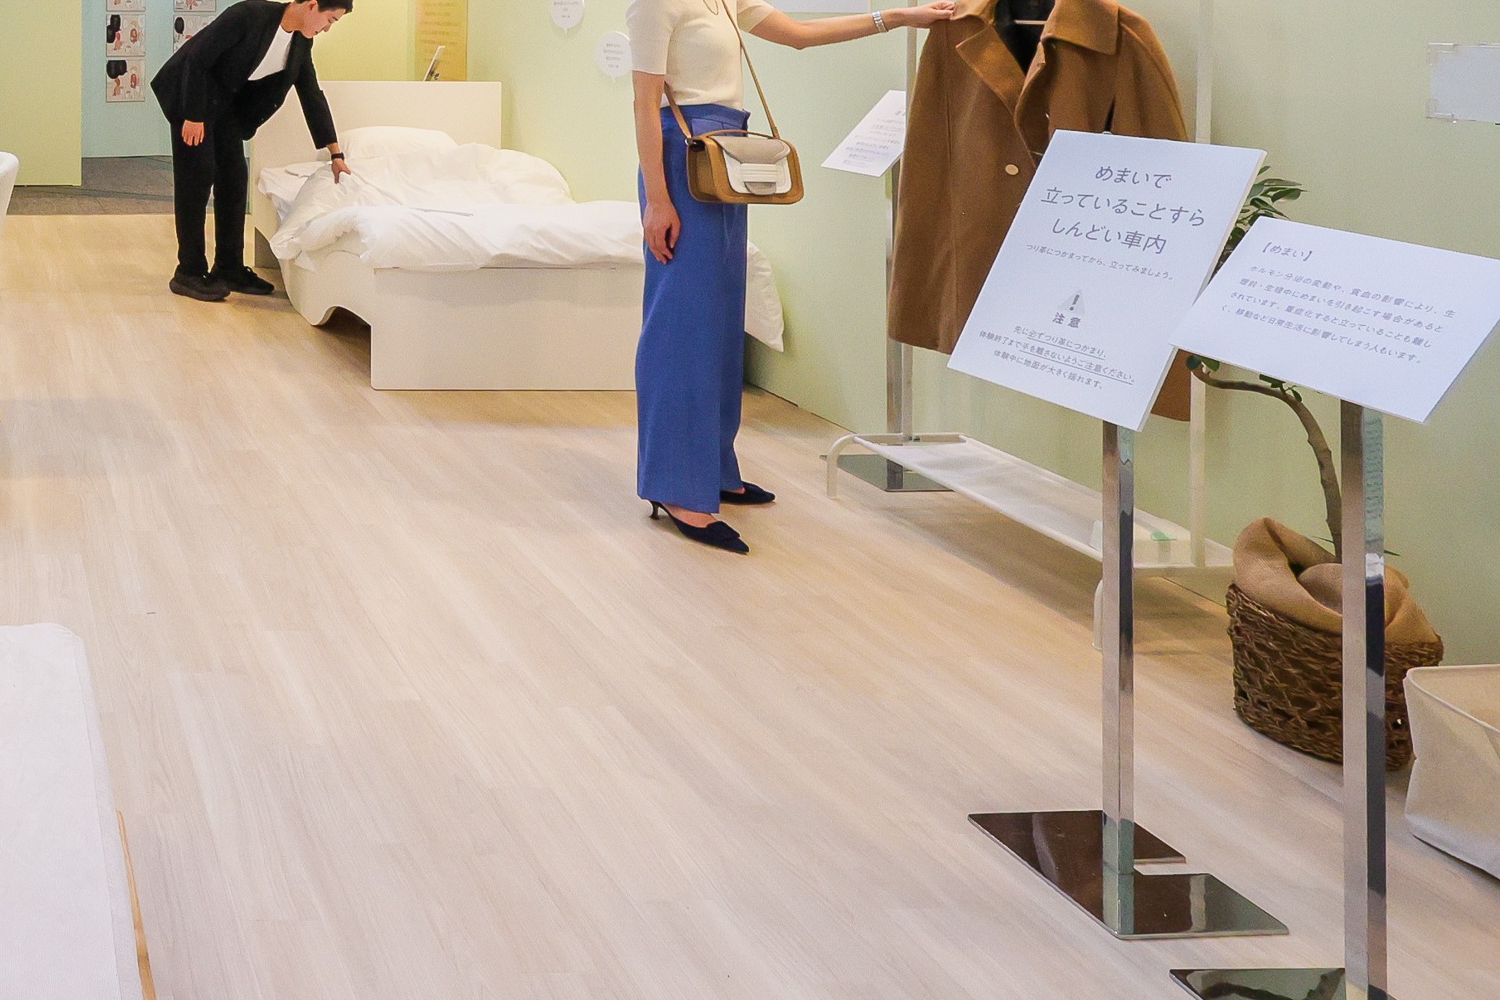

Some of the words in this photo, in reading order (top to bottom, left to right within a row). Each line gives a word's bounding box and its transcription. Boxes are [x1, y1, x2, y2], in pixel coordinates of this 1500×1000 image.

[1095, 166, 1172, 188] めまいで
[1041, 187, 1205, 227] 立っていることすら
[1052, 218, 1167, 255] しんどい車内
[1025, 244, 1173, 281] つり革につかまってから、立ってみましょう。
[1263, 242, 1313, 262] 【めまい】
[1052, 312, 1082, 329] 注意
